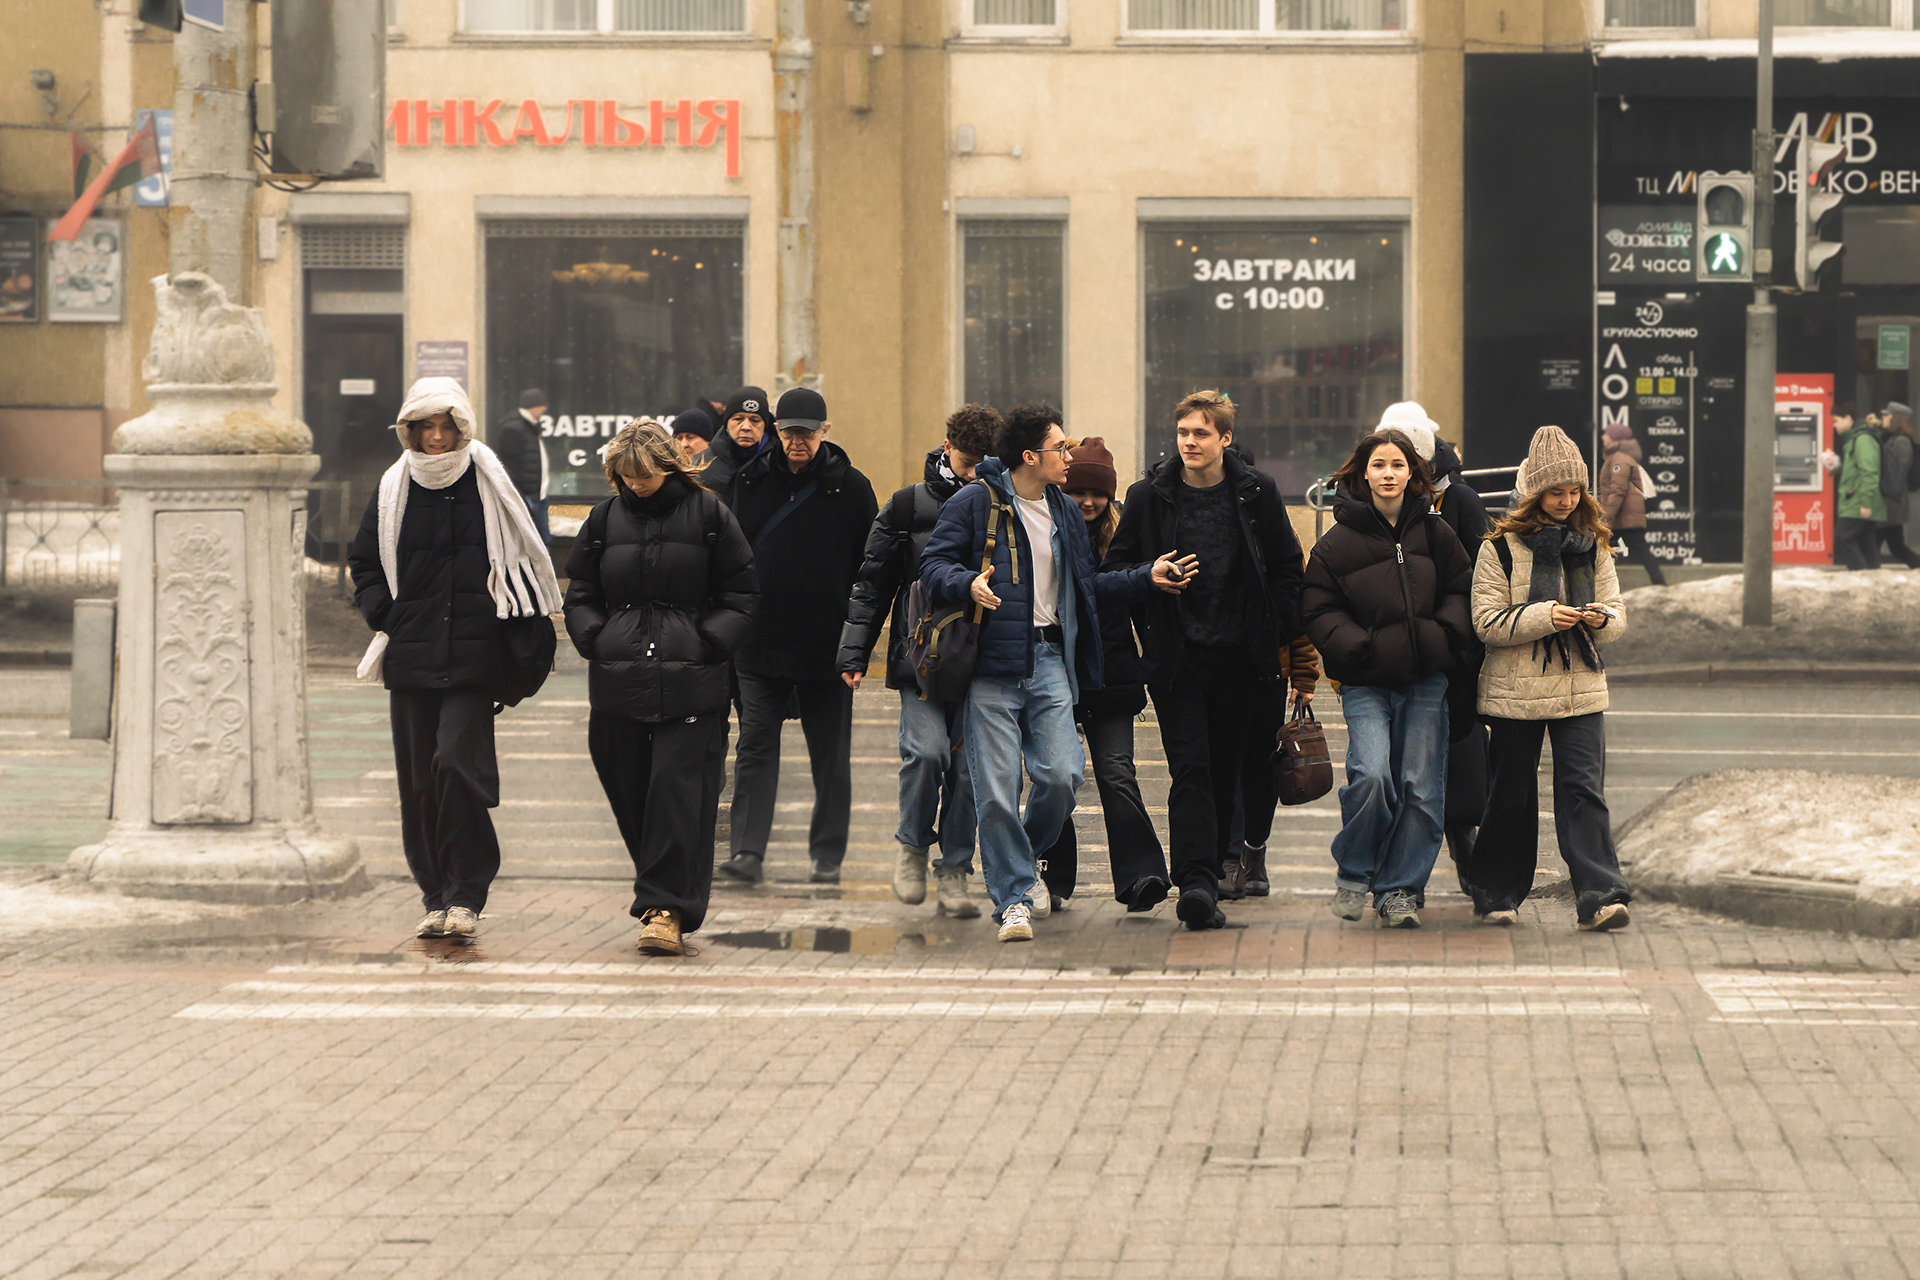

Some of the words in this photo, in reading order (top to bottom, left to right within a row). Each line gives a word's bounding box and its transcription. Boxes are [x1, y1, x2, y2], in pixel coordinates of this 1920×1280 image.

[1636, 177, 1660, 195] ТЦ
[1193, 258, 1356, 281] ЗАВТРАКИ
[1608, 253, 1636, 272] 24
[1642, 258, 1691, 272] часа
[1215, 292, 1234, 310] с
[1243, 286, 1324, 310] 10:00
[1603, 327, 1698, 338] КРУГЛОСУТОЧНО
